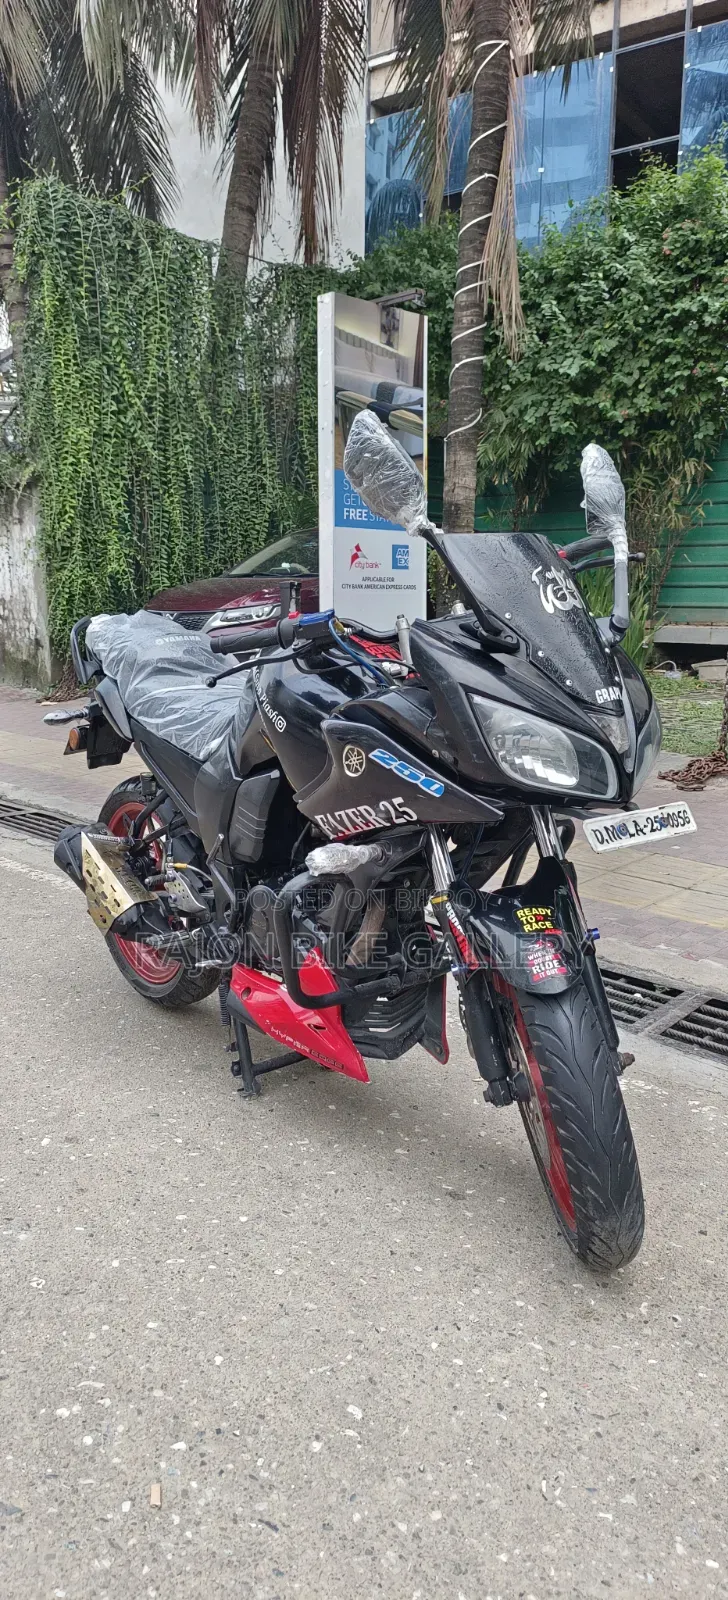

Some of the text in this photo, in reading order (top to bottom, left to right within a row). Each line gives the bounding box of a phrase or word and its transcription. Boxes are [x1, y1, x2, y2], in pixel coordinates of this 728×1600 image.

[343, 508, 368, 521] FREE
[354, 560, 365, 570] city
[397, 557, 409, 567] EX
[163, 635, 202, 643] YAMAHA
[368, 748, 445, 797] 250
[379, 796, 418, 825] 25
[516, 907, 552, 918] READY
[520, 915, 536, 925] TO
[523, 921, 553, 933] RACE
[532, 959, 560, 974] RIDE
